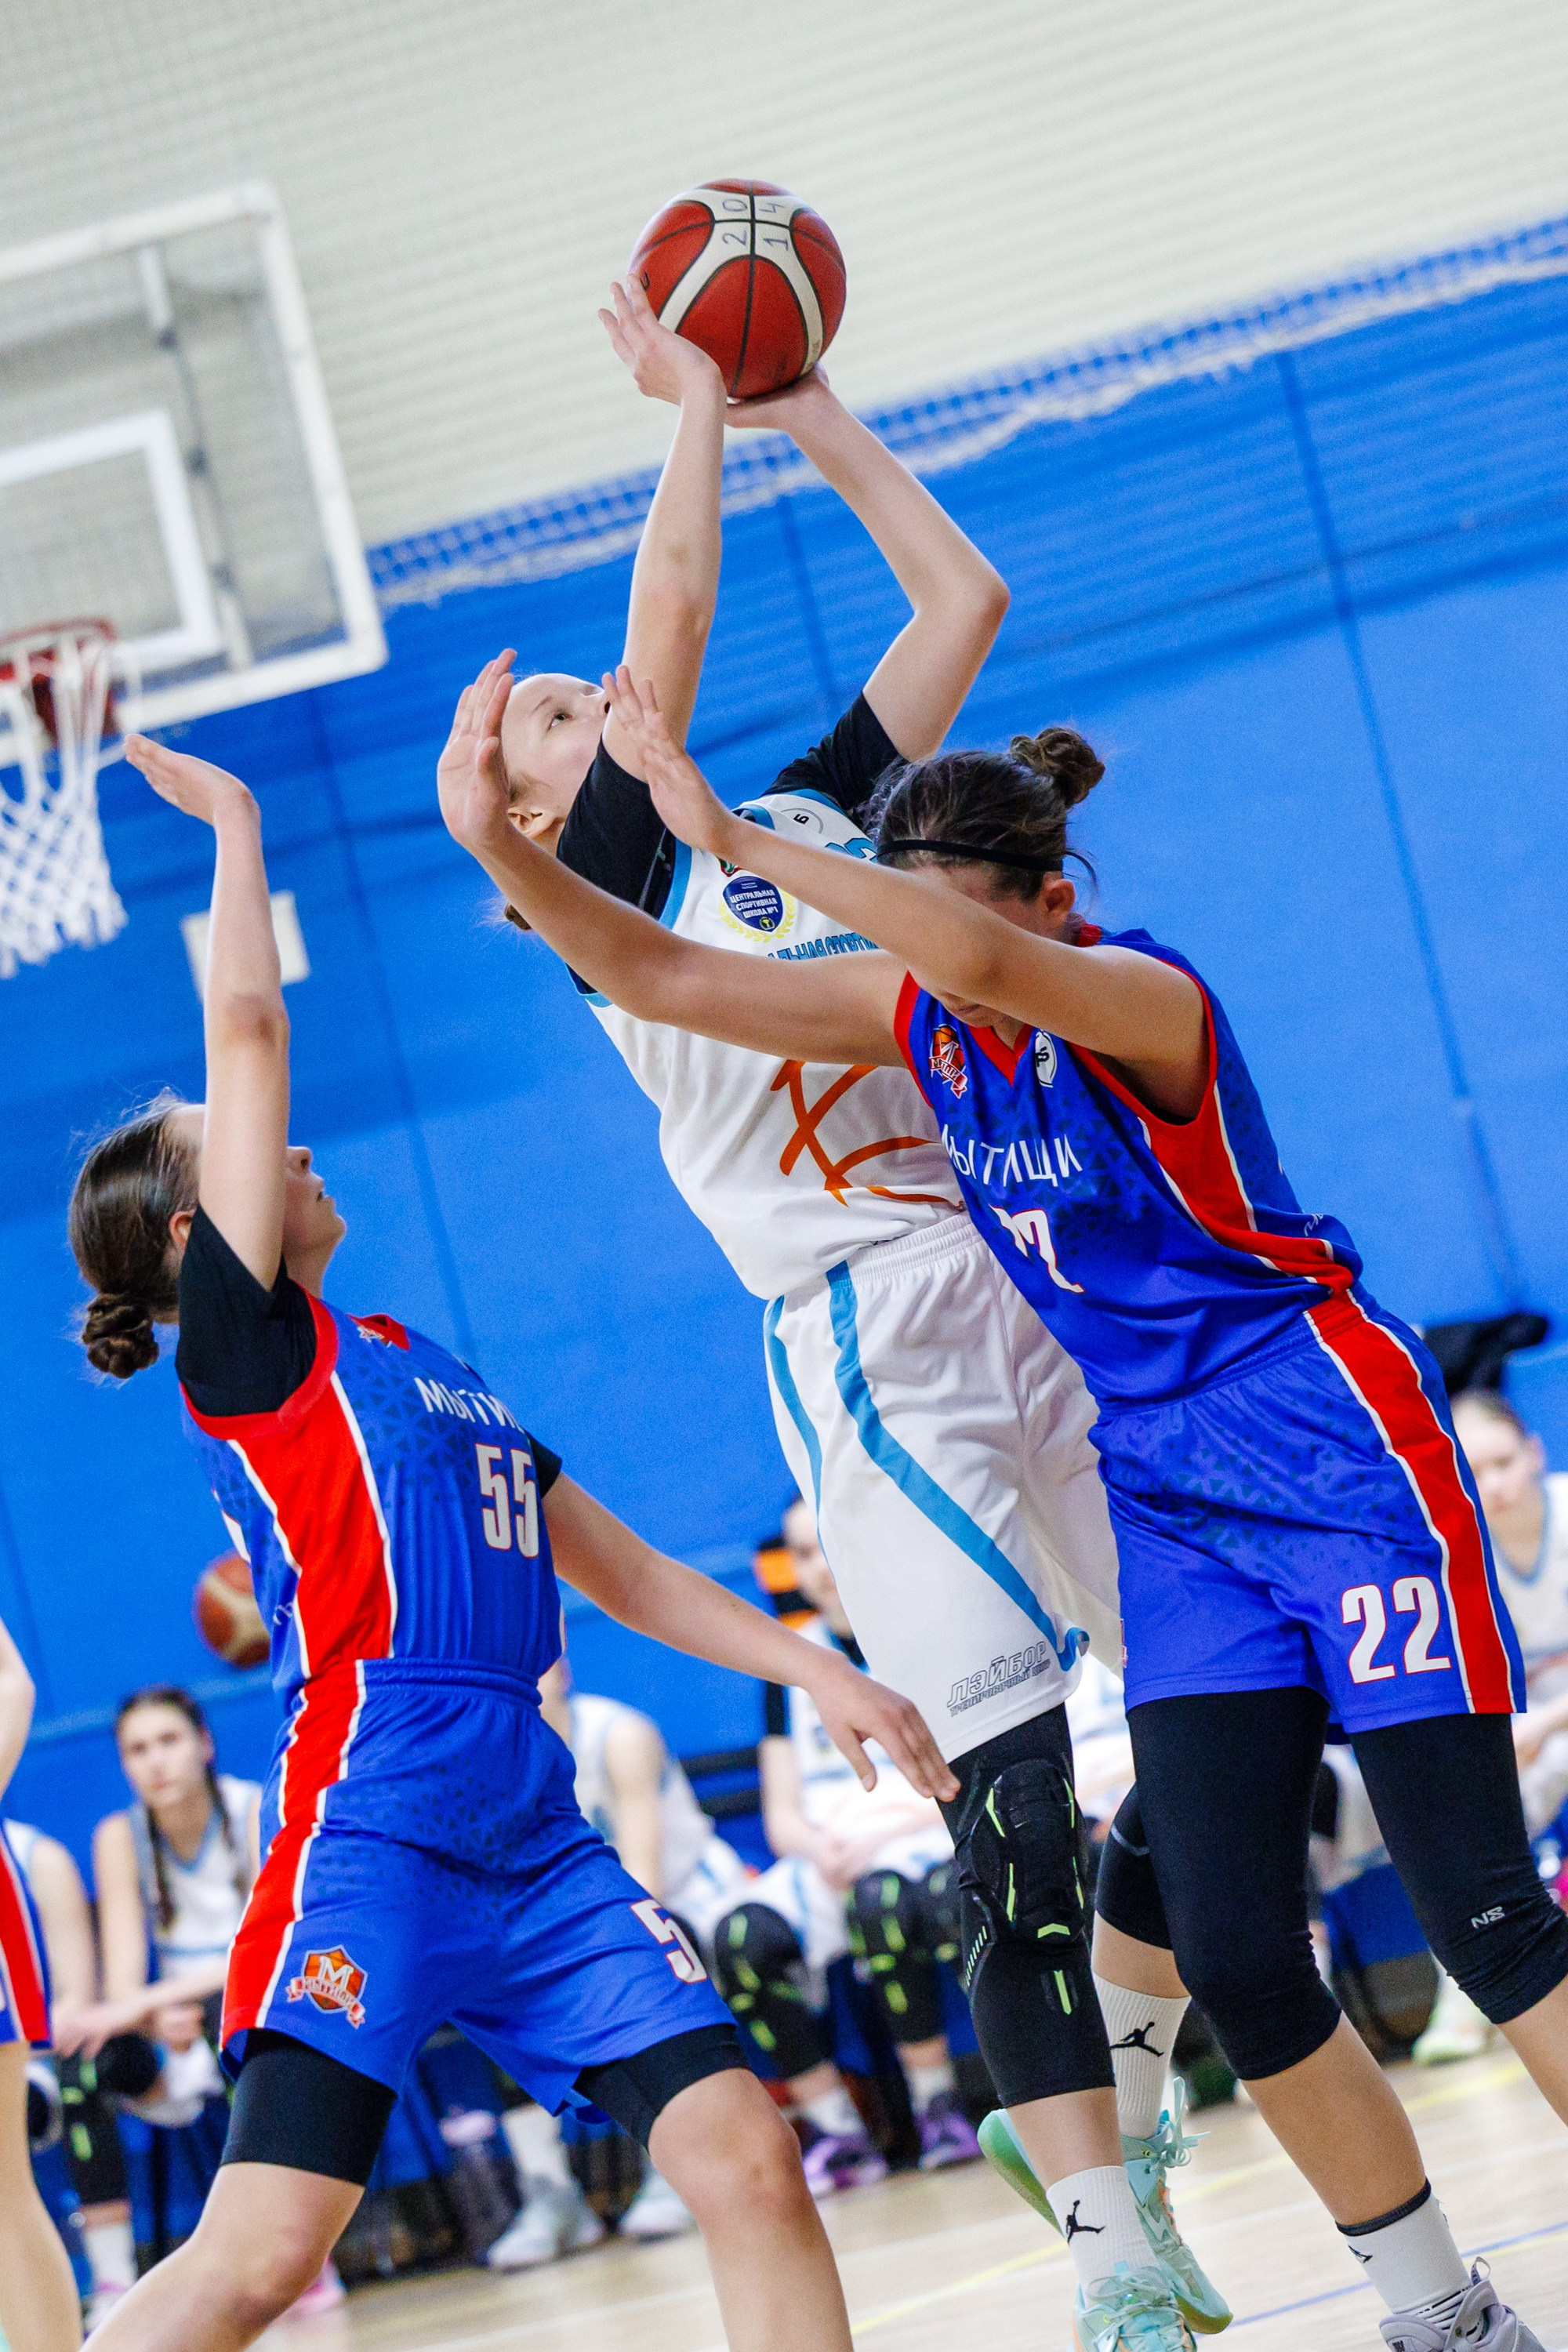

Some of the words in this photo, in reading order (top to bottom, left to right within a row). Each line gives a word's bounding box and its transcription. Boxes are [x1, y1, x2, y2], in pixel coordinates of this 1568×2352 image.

[729, 889, 775, 903] ЦЕНТРАЛЬНАЯ
[735, 898, 779, 911] СПОРТИВНАЯ
[742, 908, 768, 919] ШКОЛА
[474, 1442, 540, 1559] 55
[1341, 1575, 1452, 1685] 22
[946, 1641, 1047, 1708] ЛЭЙБОР
